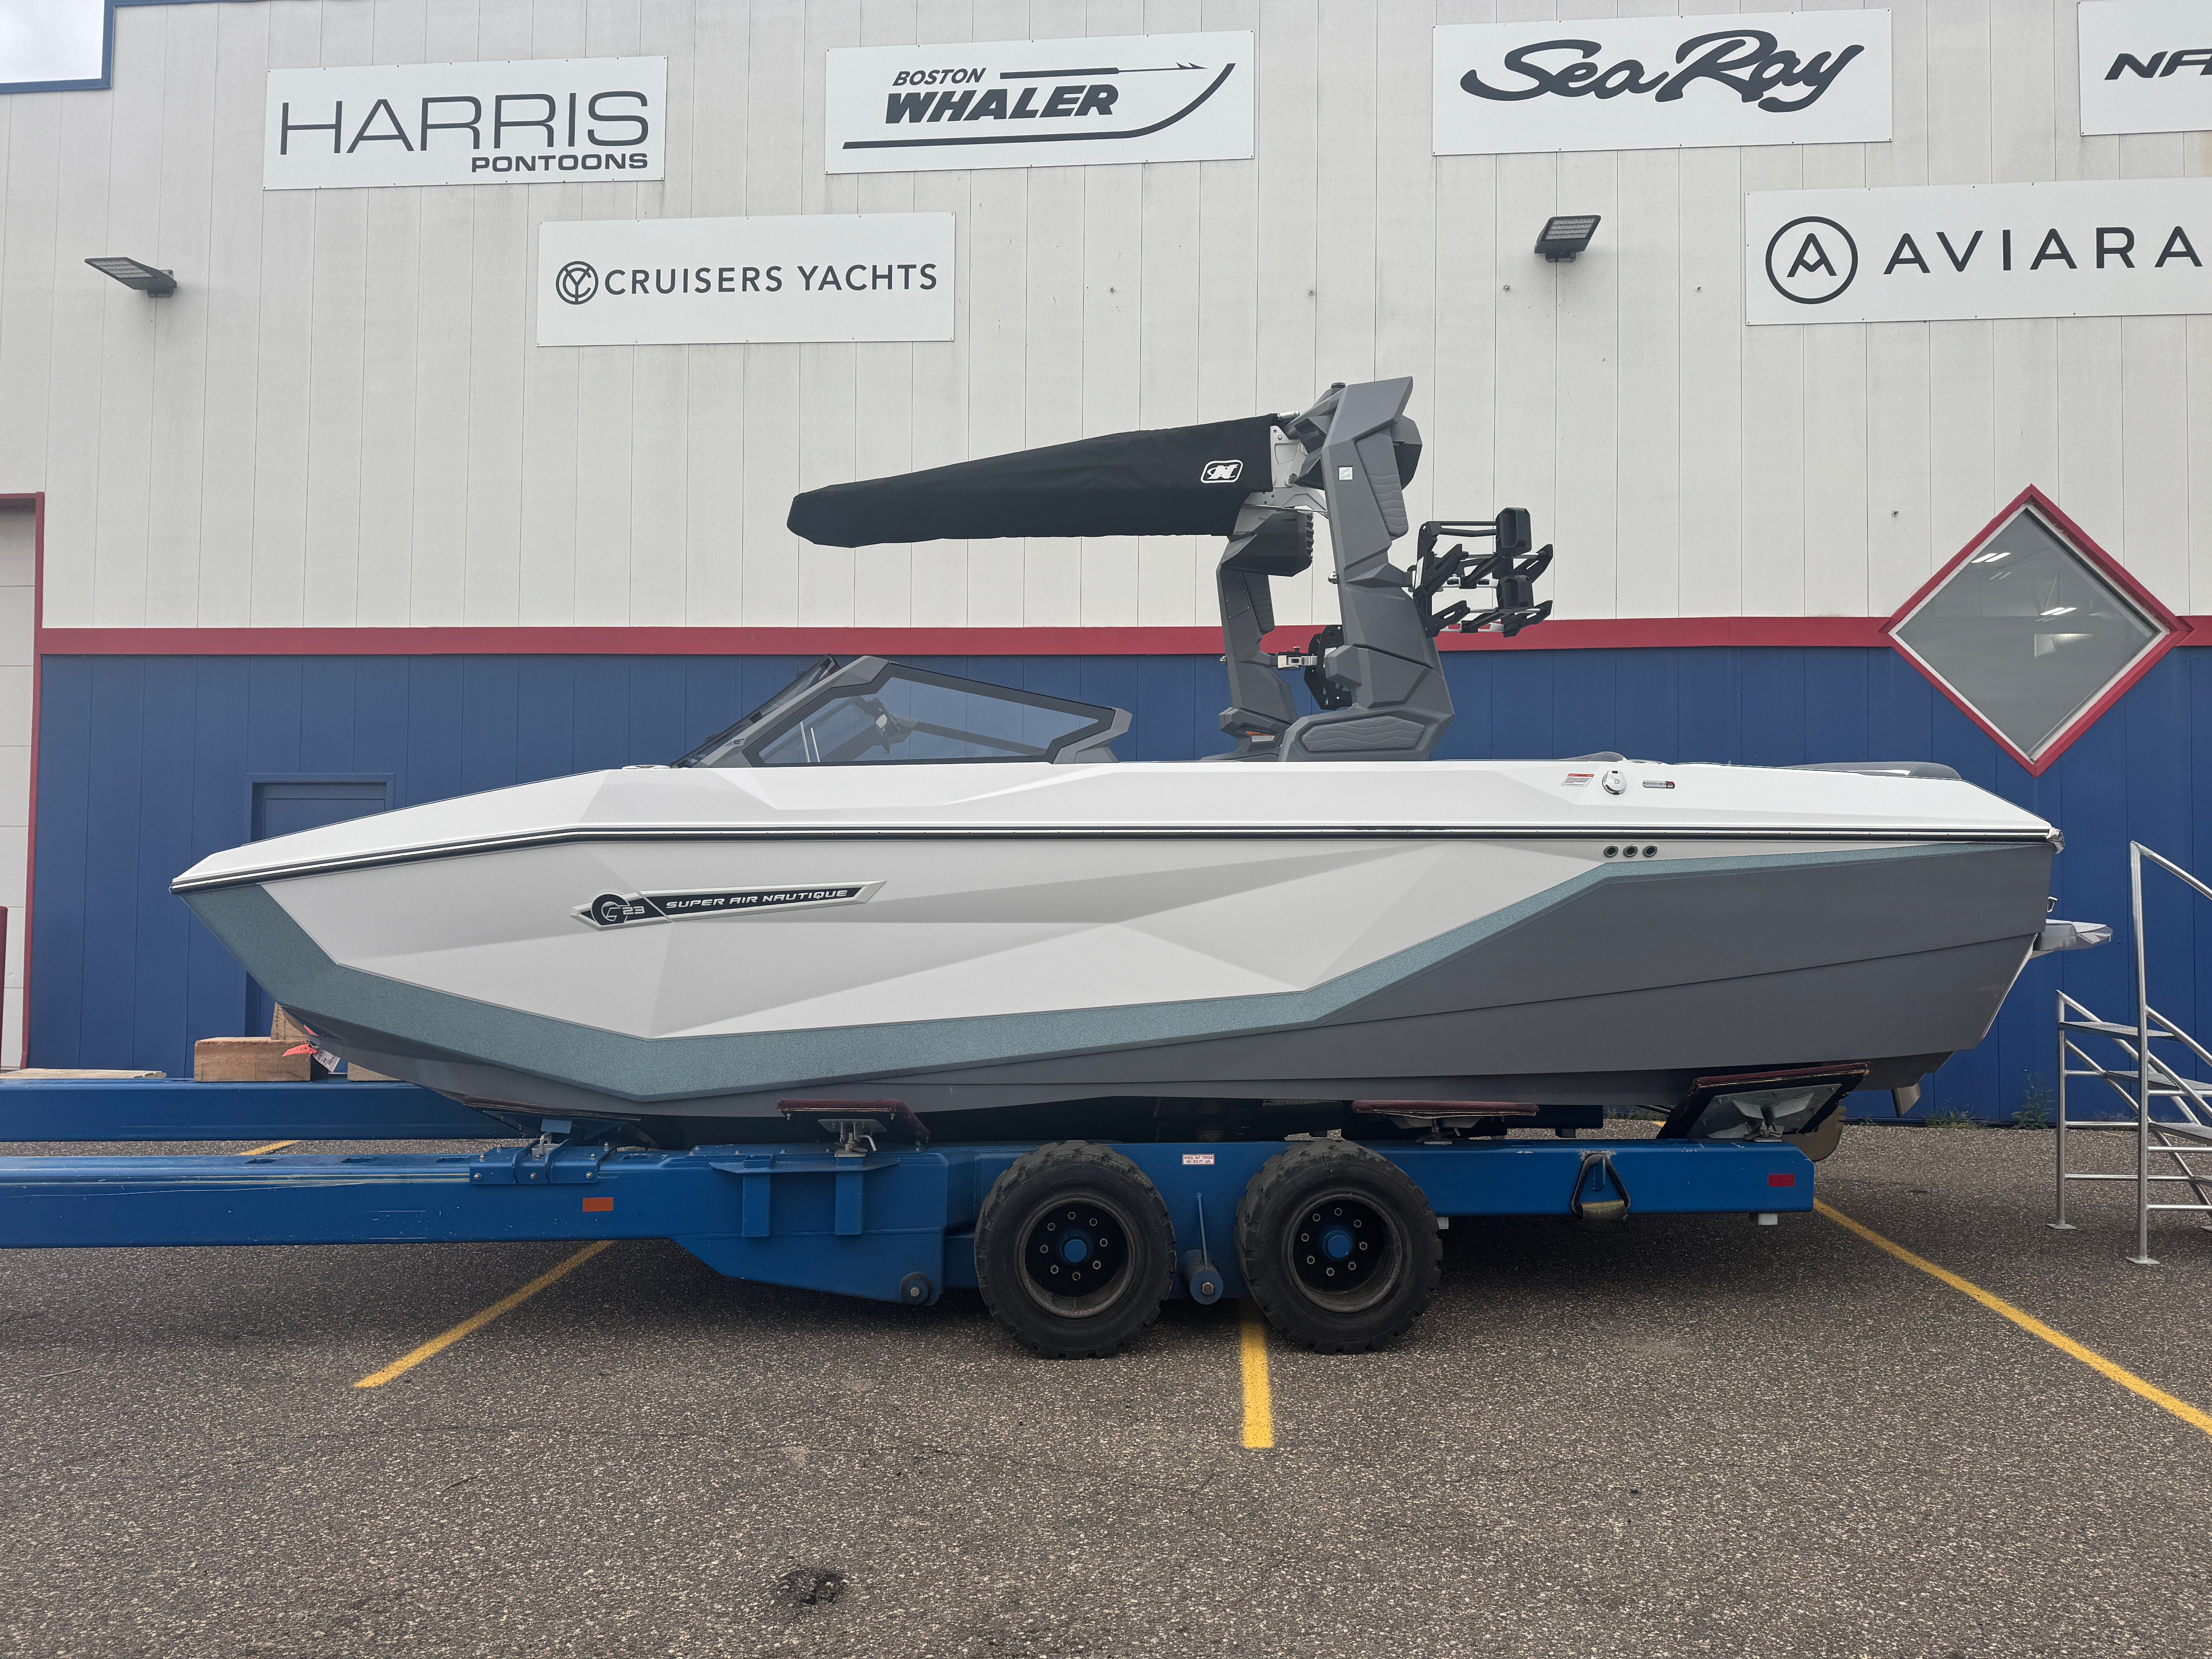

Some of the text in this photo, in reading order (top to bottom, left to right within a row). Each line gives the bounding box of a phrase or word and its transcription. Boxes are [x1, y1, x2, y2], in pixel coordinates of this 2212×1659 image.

[892, 67, 987, 86] BOSTON
[1460, 29, 1865, 113] Sea Ray
[885, 84, 1119, 124] WHALER
[280, 91, 649, 155] HARRIS
[471, 153, 648, 173] PONTOONS
[1883, 226, 2203, 275] AVIARA
[605, 266, 782, 295] CRUISERS
[797, 263, 937, 291] YACHTS
[666, 898, 725, 908] SUPER
[729, 896, 758, 905] AIR
[762, 890, 848, 902] NAUTIQUE
